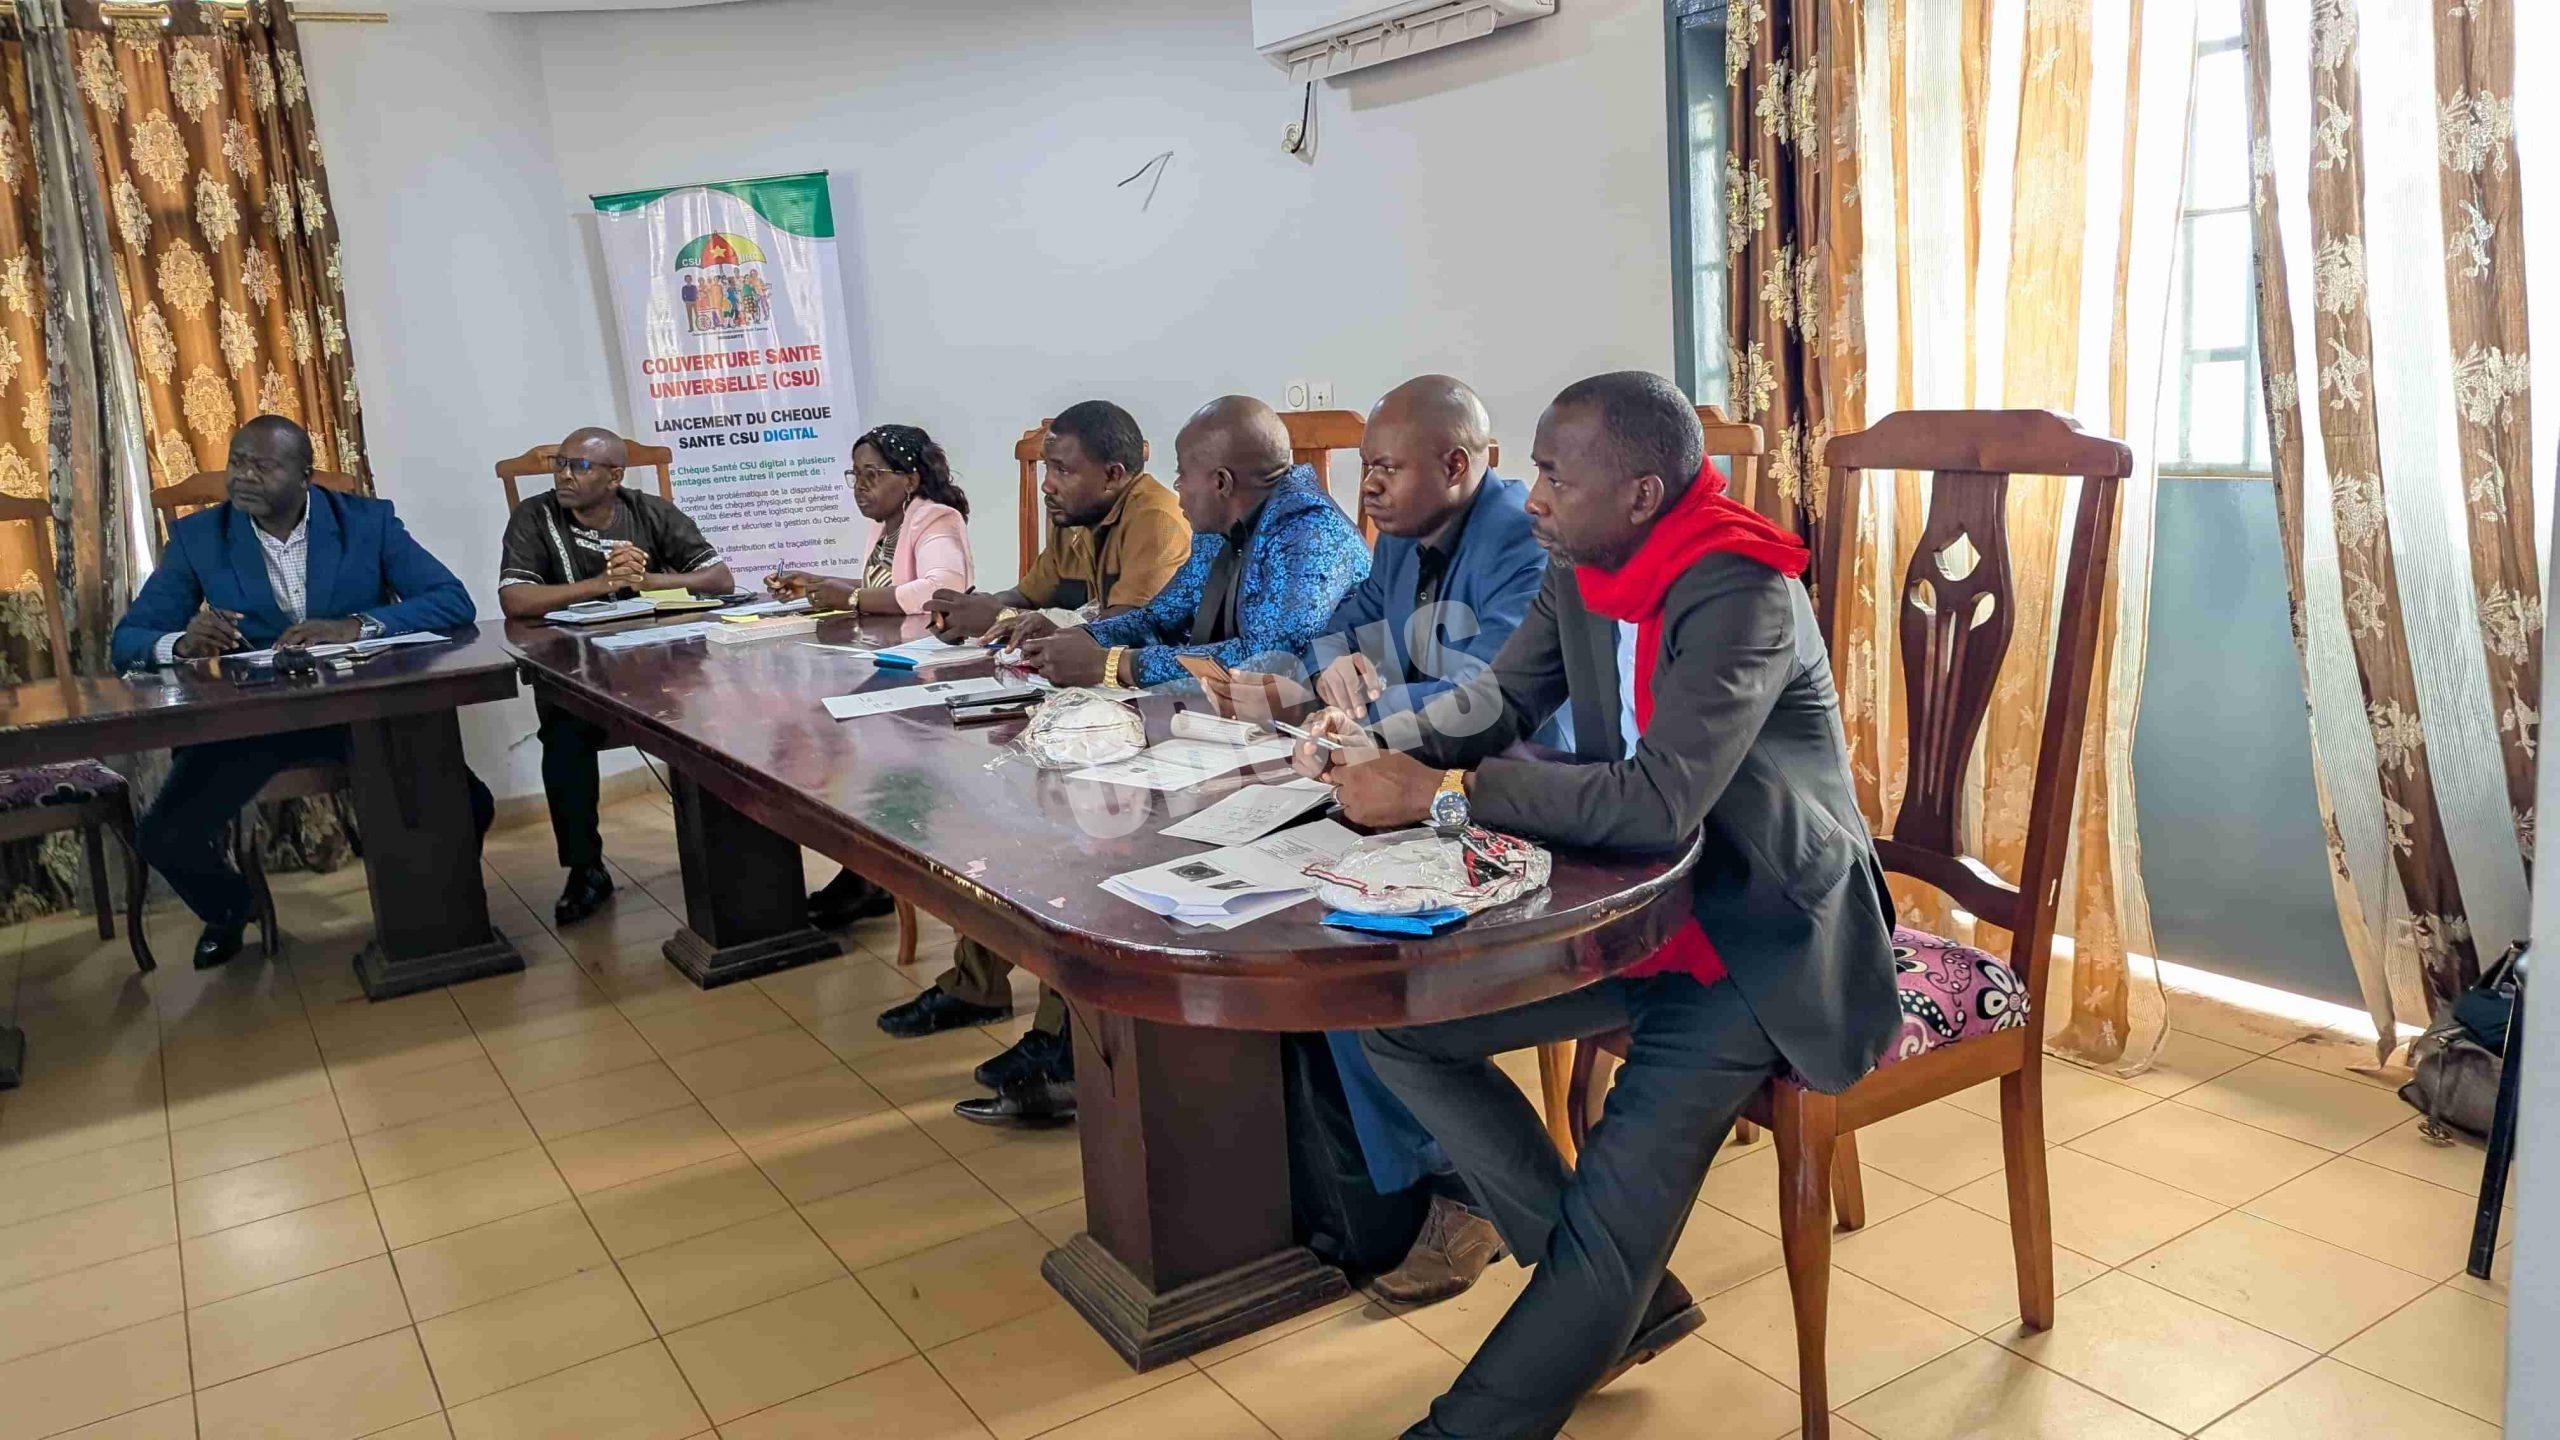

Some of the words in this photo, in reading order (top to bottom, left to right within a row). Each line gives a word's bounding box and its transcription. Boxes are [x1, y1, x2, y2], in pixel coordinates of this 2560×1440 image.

[642, 349, 761, 375] COUVERTURE
[766, 344, 822, 364] SANTE
[650, 373, 768, 400] UNIVERSELLE
[773, 367, 820, 391] (CSU)
[655, 413, 742, 433] LANCEMENT
[746, 411, 767, 425] DU
[771, 406, 831, 424] CHEQUE
[679, 433, 725, 450] SANTE
[729, 430, 760, 445] CSU
[763, 426, 818, 443] DIGITAL
[678, 465, 710, 476] Chèque
[712, 462, 737, 472] Santé
[740, 461, 757, 470] CSU
[759, 458, 787, 469] digital
[797, 456, 836, 466] plusieurs
[672, 477, 711, 486] vantages
[713, 475, 737, 483] entre
[739, 473, 766, 481] autres
[776, 469, 808, 480] permet
[810, 468, 820, 476] de
[716, 489, 768, 501] problématique
[770, 488, 779, 496] de
[790, 484, 832, 495] disponibilité
[710, 502, 722, 510] des
[769, 506, 804, 516] logistique
[700, 525, 729, 533] dardiser
[726, 543, 766, 552] distribution
